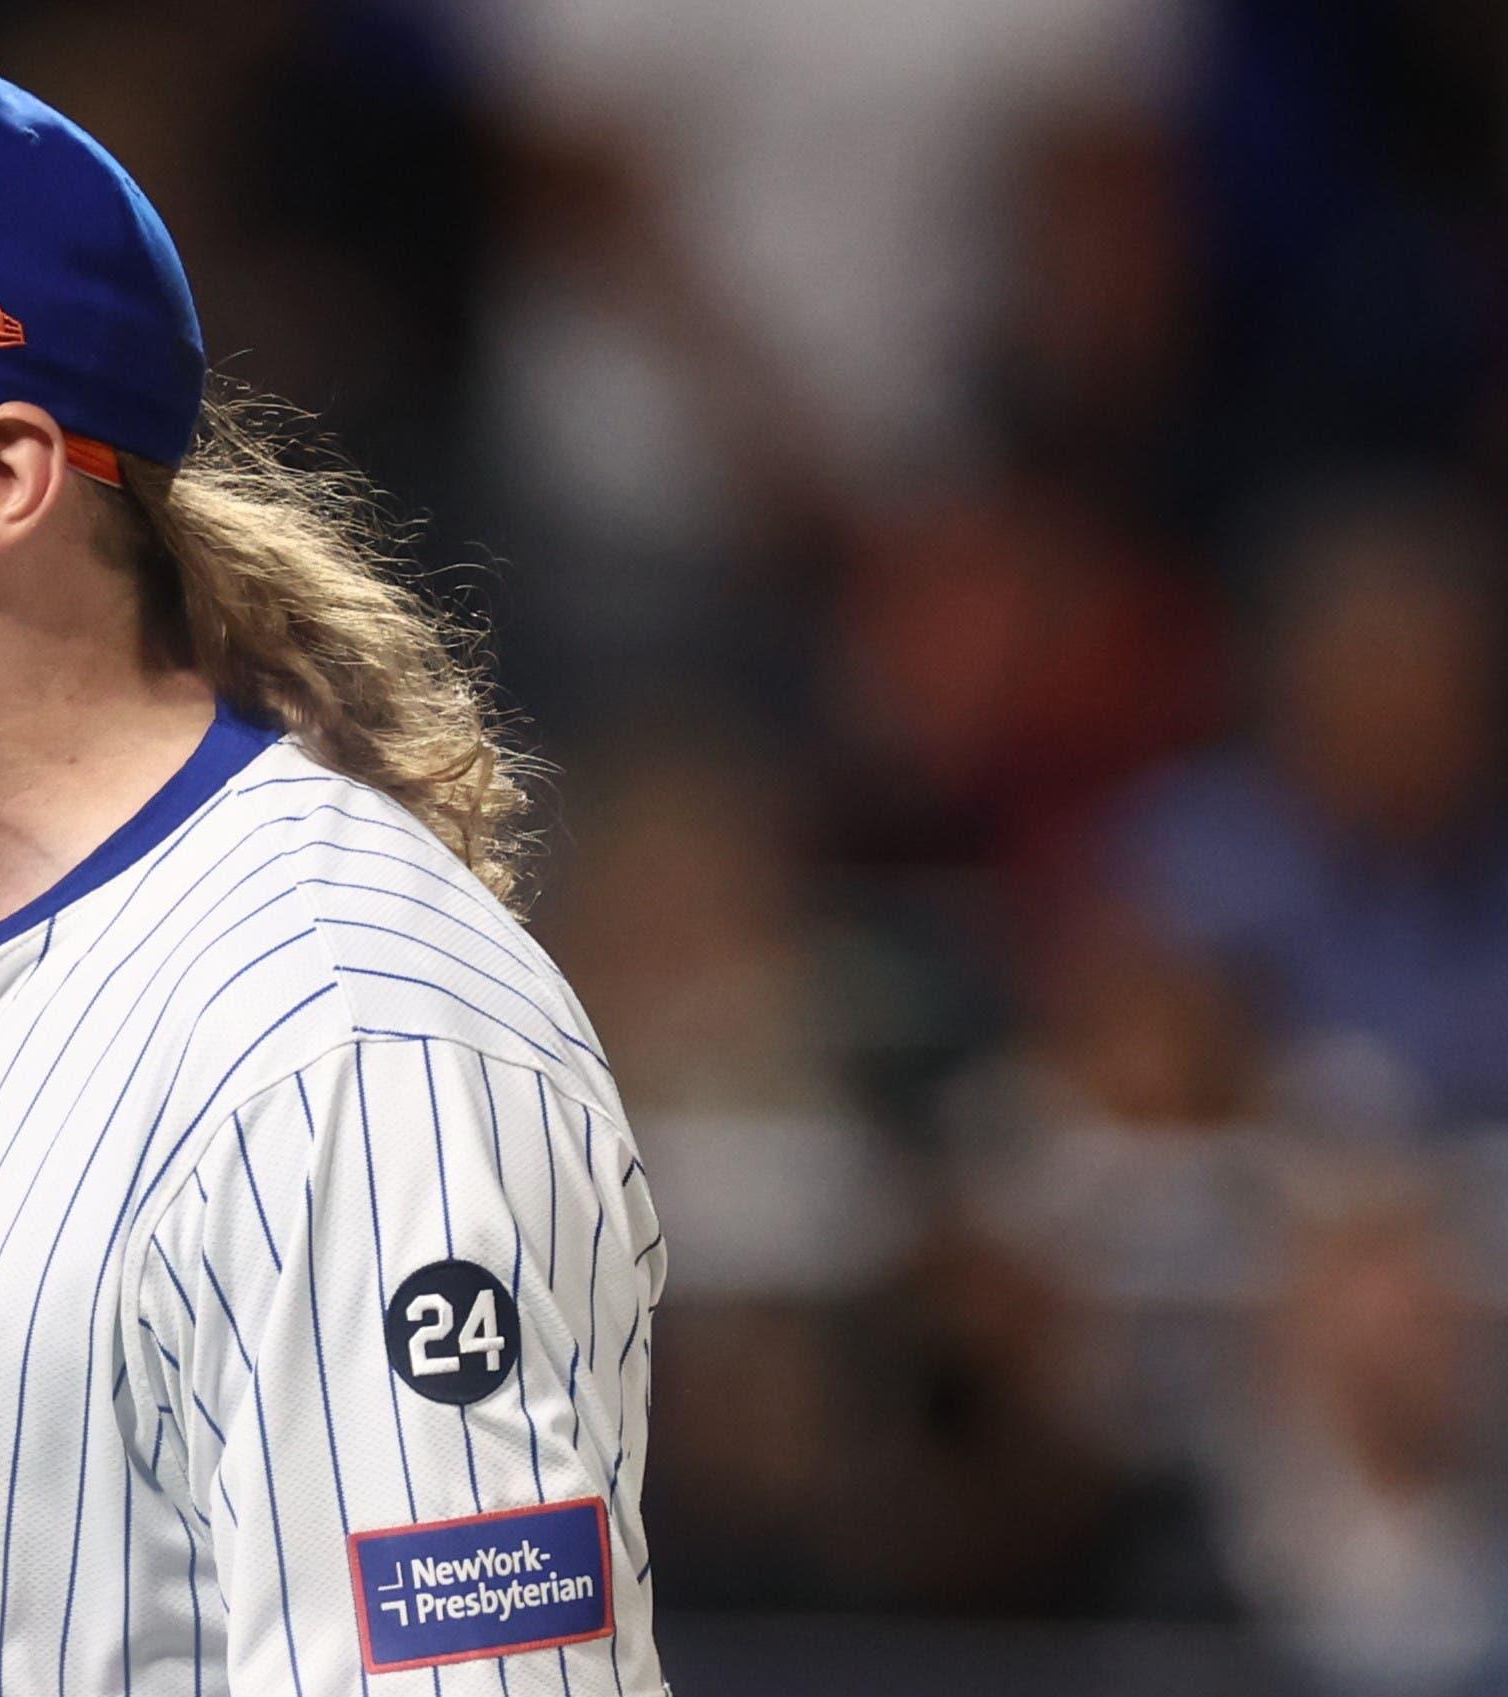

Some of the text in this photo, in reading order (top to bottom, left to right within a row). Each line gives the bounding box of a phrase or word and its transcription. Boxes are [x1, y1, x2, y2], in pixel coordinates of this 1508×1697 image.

[406, 1289, 505, 1376] 24
[411, 1540, 551, 1590] NewYork-
[416, 1572, 594, 1624] Presbyterian
